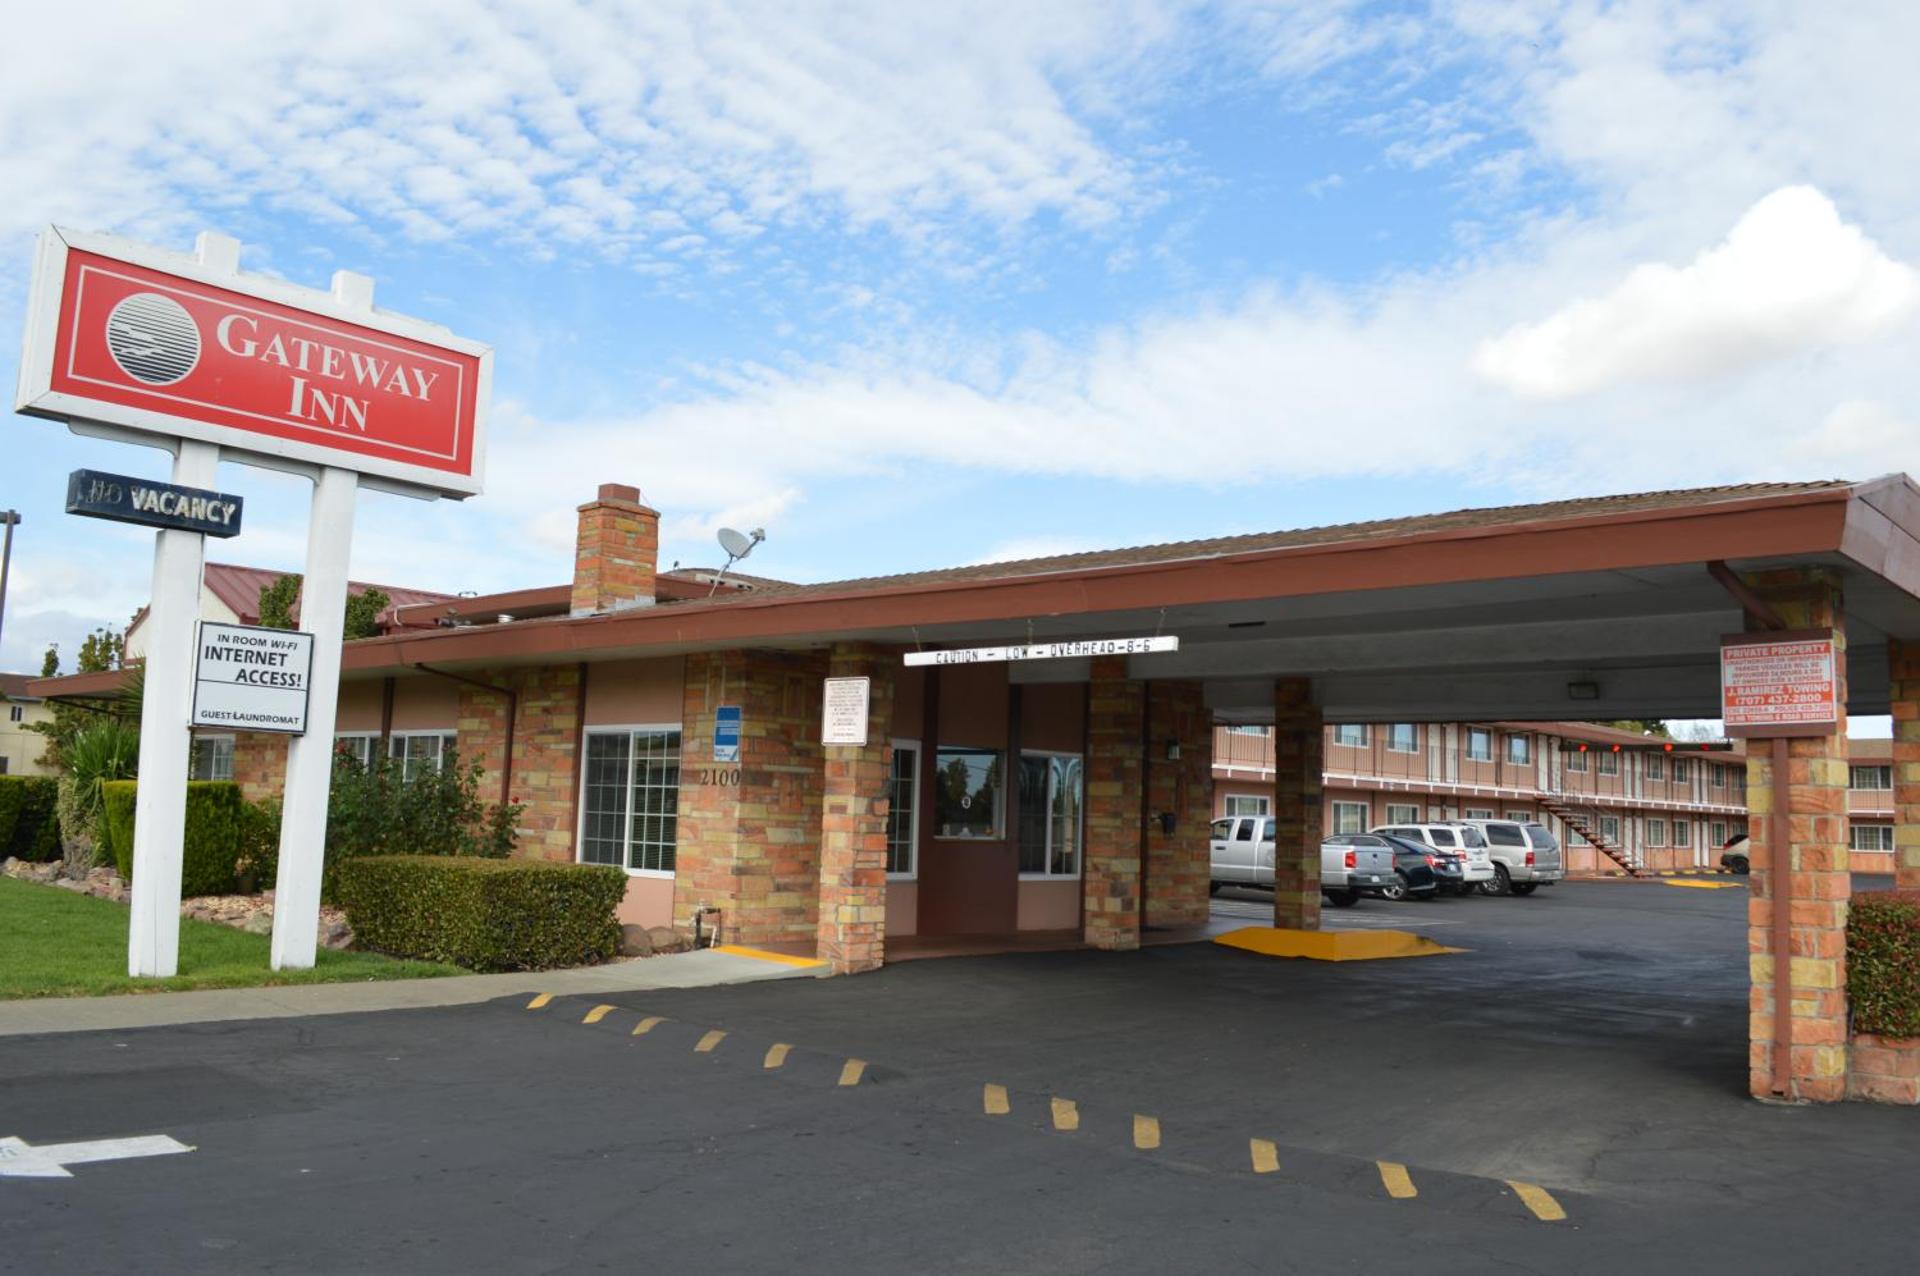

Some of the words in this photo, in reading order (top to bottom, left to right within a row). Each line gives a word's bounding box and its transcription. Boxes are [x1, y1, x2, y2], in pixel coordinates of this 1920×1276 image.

[216, 313, 439, 402] GATEWAY
[286, 375, 370, 432] INN
[130, 485, 236, 526] VACANCY
[217, 633, 230, 643] IN
[232, 634, 267, 647] ROOM
[271, 639, 298, 651] WI-FI
[1727, 646, 1769, 657] PRIVATE
[1771, 643, 1826, 656] PROPERTY
[204, 645, 288, 667] INTERNET
[936, 652, 979, 664] CAUTION
[1006, 648, 1028, 660] LOW
[235, 668, 302, 688] ACCESS!
[1788, 682, 1830, 694] TOWING
[1736, 695, 1764, 705] (707)
[1768, 693, 1822, 704] 437-2800
[702, 769, 740, 786] 2100
